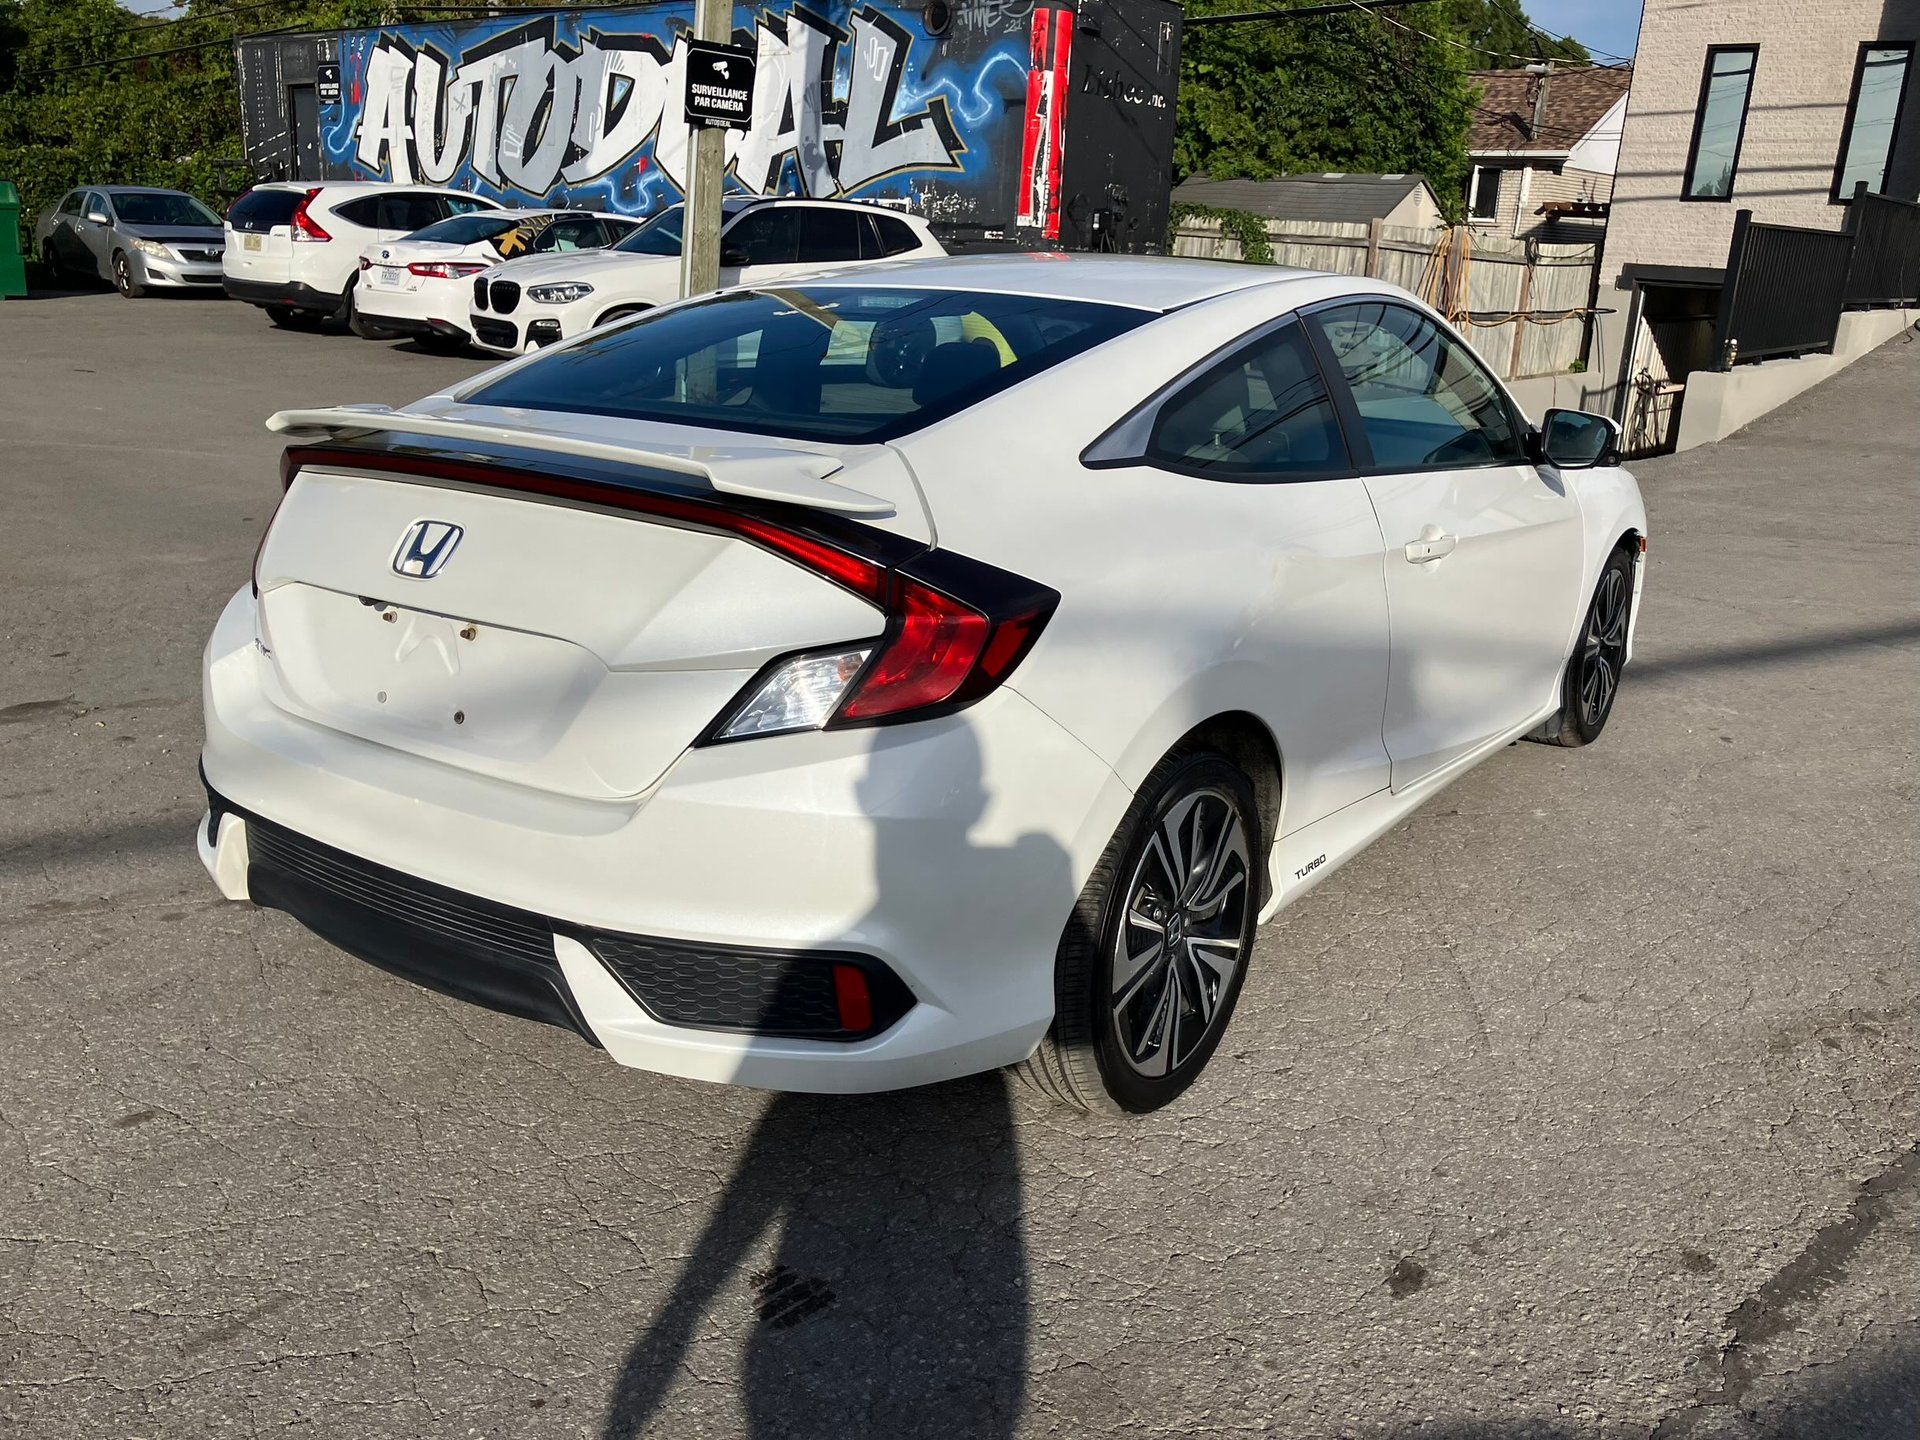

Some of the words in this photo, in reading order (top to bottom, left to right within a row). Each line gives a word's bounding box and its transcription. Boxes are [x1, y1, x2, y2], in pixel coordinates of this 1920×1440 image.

[691, 83, 748, 101] SURVEILLANCE
[694, 95, 711, 108] PAR
[711, 98, 744, 112] CAMÉRA
[1293, 853, 1327, 880] TURBO
